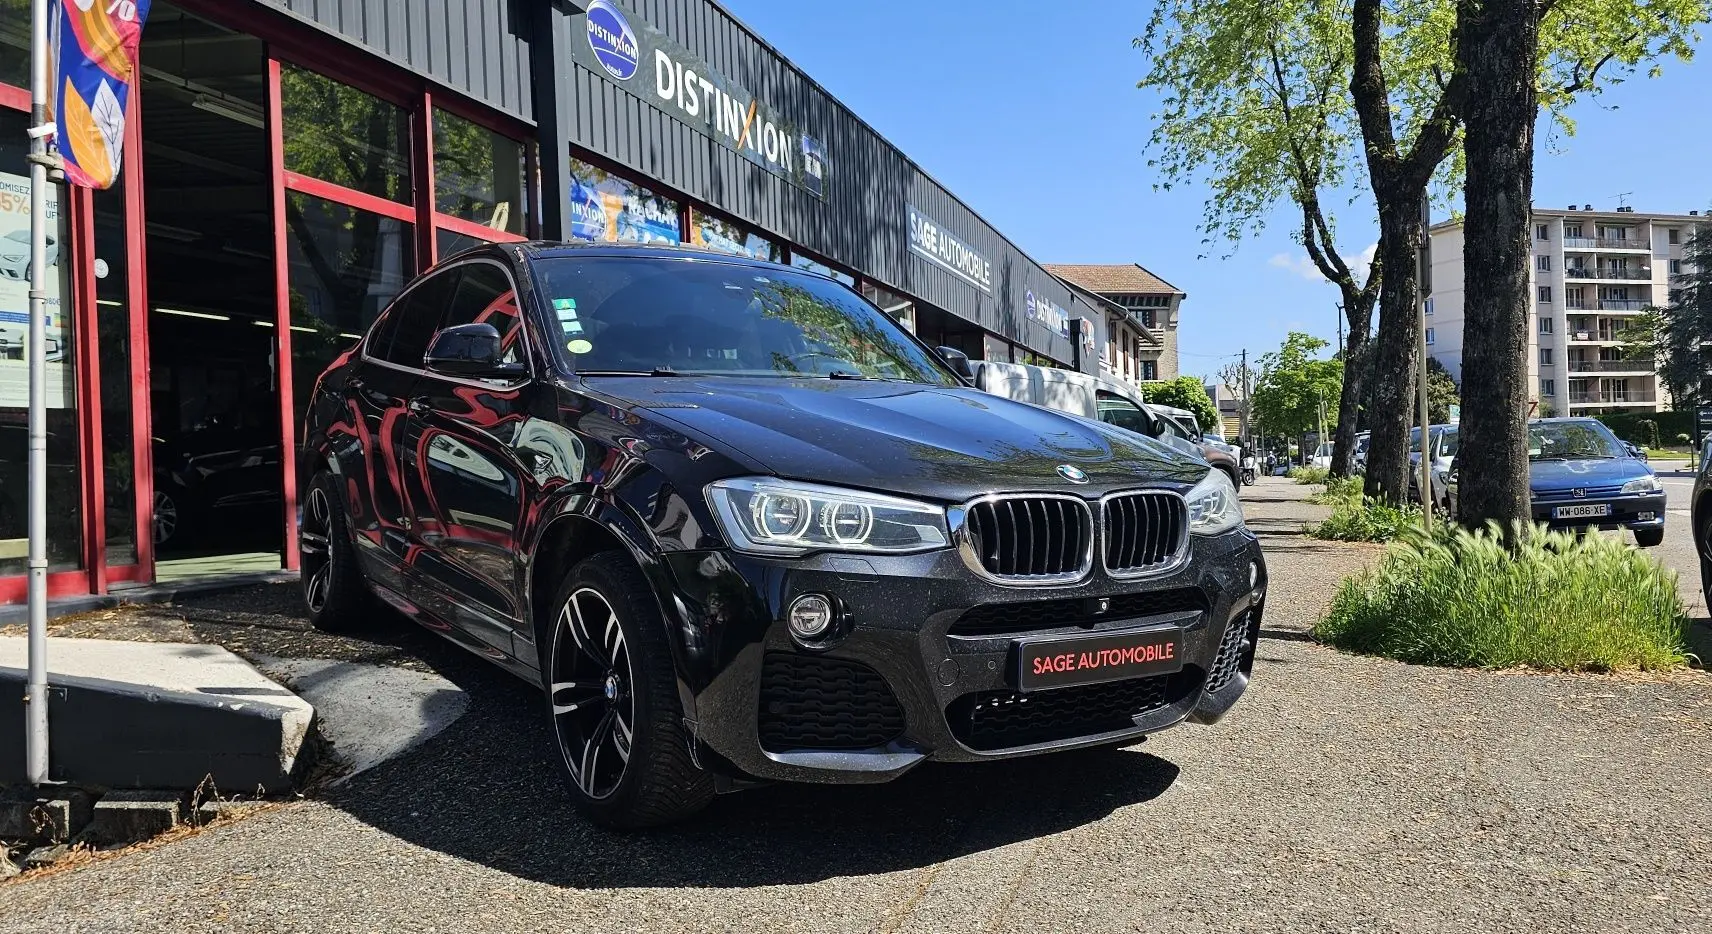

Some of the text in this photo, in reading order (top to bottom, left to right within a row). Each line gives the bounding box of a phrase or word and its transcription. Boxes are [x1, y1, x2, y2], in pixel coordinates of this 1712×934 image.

[588, 20, 636, 60] DISTINXION
[655, 48, 793, 173] DISTINXION
[910, 212, 991, 285] SAGE AUTOMOBILE
[1559, 505, 1606, 517] WW-086-XE
[1033, 642, 1174, 674] SAGE AUTOMOBILE
